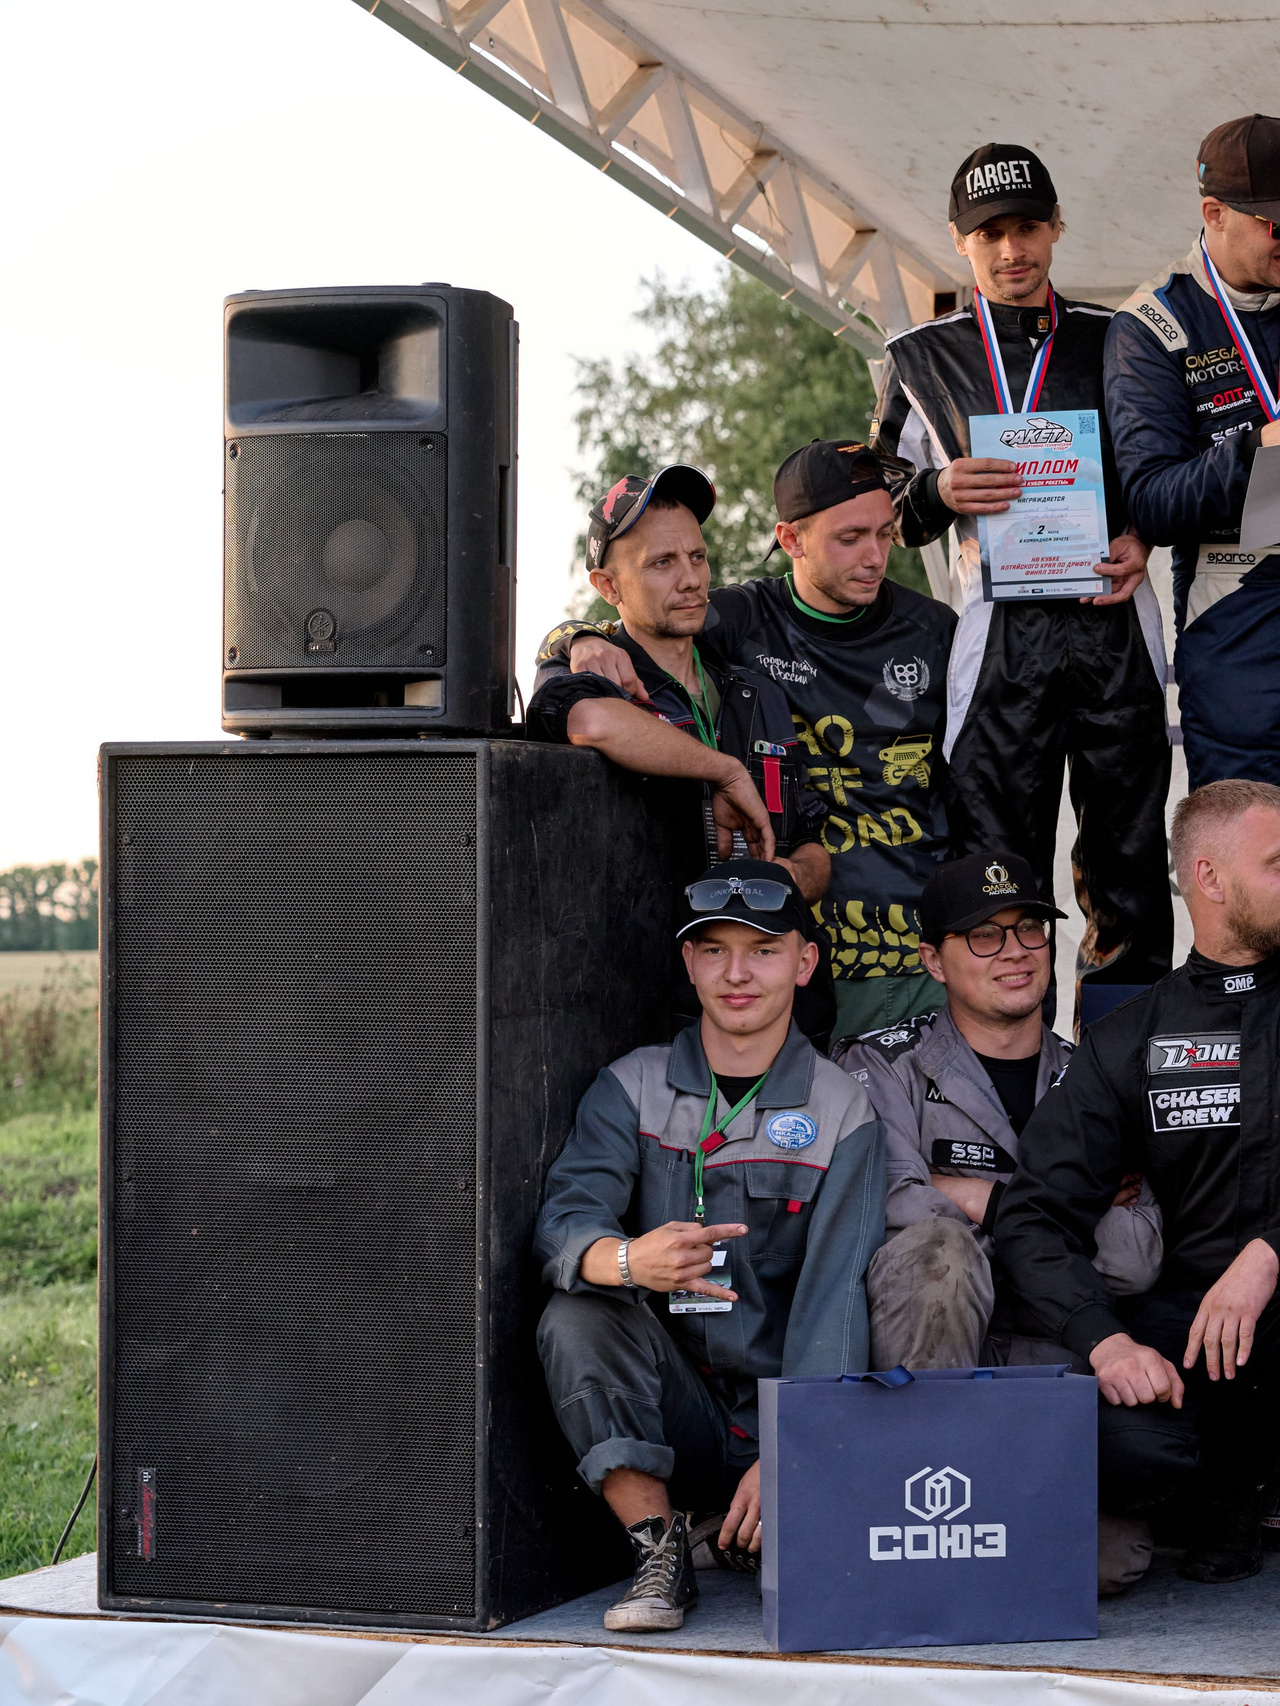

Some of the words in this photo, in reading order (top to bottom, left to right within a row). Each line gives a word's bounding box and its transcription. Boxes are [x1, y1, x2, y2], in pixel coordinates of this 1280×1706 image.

[965, 160, 1031, 194] TARGET
[968, 187, 1001, 200] ENERGY
[1005, 183, 1032, 191] DRINK
[1137, 303, 1178, 342] sparco
[1185, 346, 1239, 369] OMEGA
[1211, 398, 1252, 414] НОВОСИБИРСК
[1001, 428, 1073, 446] РАКЕТА
[1015, 459, 1079, 475] ИПЛОМ
[1017, 496, 1065, 504] НАГРАЖДАЕТСЯ
[1037, 525, 1045, 535] 2
[1000, 563, 1039, 571] АЛТАЙСКОГО
[1066, 560, 1092, 568] ДРИФТУ
[1207, 552, 1256, 566] sparco
[820, 807, 922, 855] OAD
[982, 882, 1019, 893] OMEGA
[989, 888, 1017, 896] MOTORS
[1224, 975, 1254, 991] OMP
[1155, 1087, 1240, 1109] CHASER
[1166, 1106, 1234, 1126] CREW
[951, 1142, 995, 1161] SSP
[869, 1523, 1006, 1561] СОЮЗ
